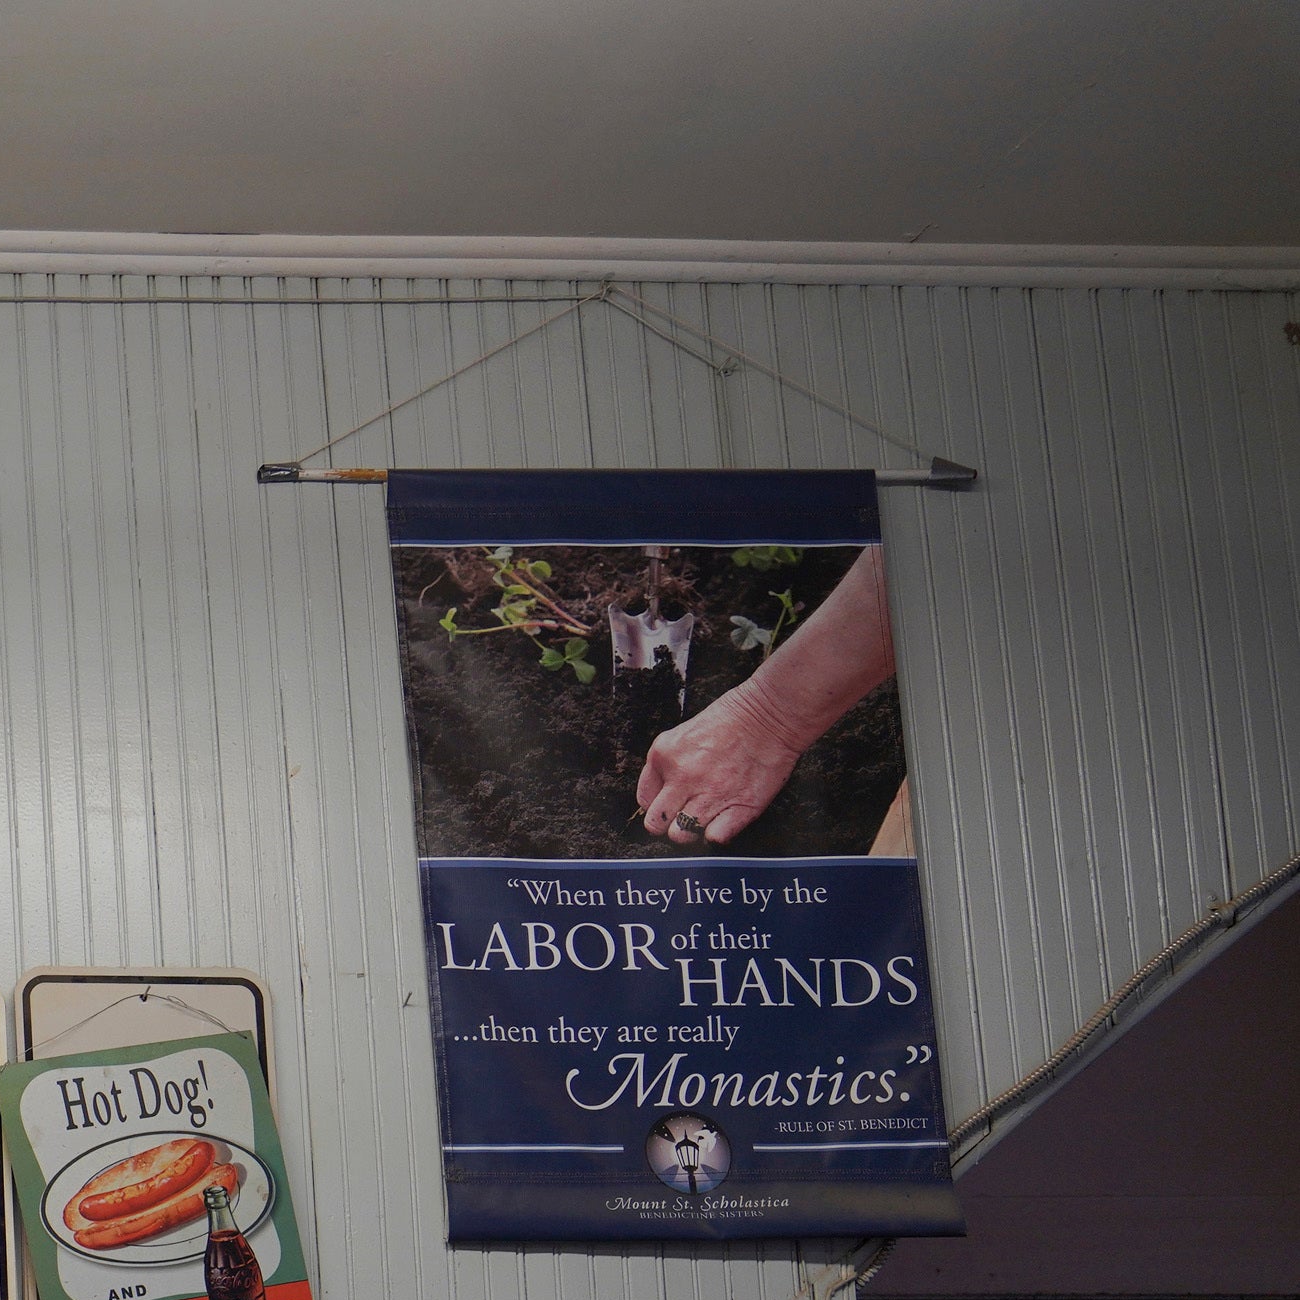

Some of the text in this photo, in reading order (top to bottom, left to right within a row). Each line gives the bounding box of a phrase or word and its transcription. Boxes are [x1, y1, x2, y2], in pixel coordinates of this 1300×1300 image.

[616, 880, 675, 913] they
[686, 879, 733, 904] live
[741, 878, 773, 912] by
[783, 878, 828, 904] the
[437, 922, 772, 971] LABOR of their
[675, 956, 918, 1008] HANDS
[549, 1016, 608, 1050] they
[617, 1024, 658, 1043] are
[667, 1016, 740, 1050] really
[56, 1060, 214, 1130] Hot Dog!
[816, 1119, 834, 1132] OF
[837, 1118, 858, 1132] ST.
[860, 1116, 929, 1131] BENEDICT
[605, 1194, 790, 1212] Mount St. Scholastica
[639, 1209, 764, 1220] BENEDICTINE SISTERS
